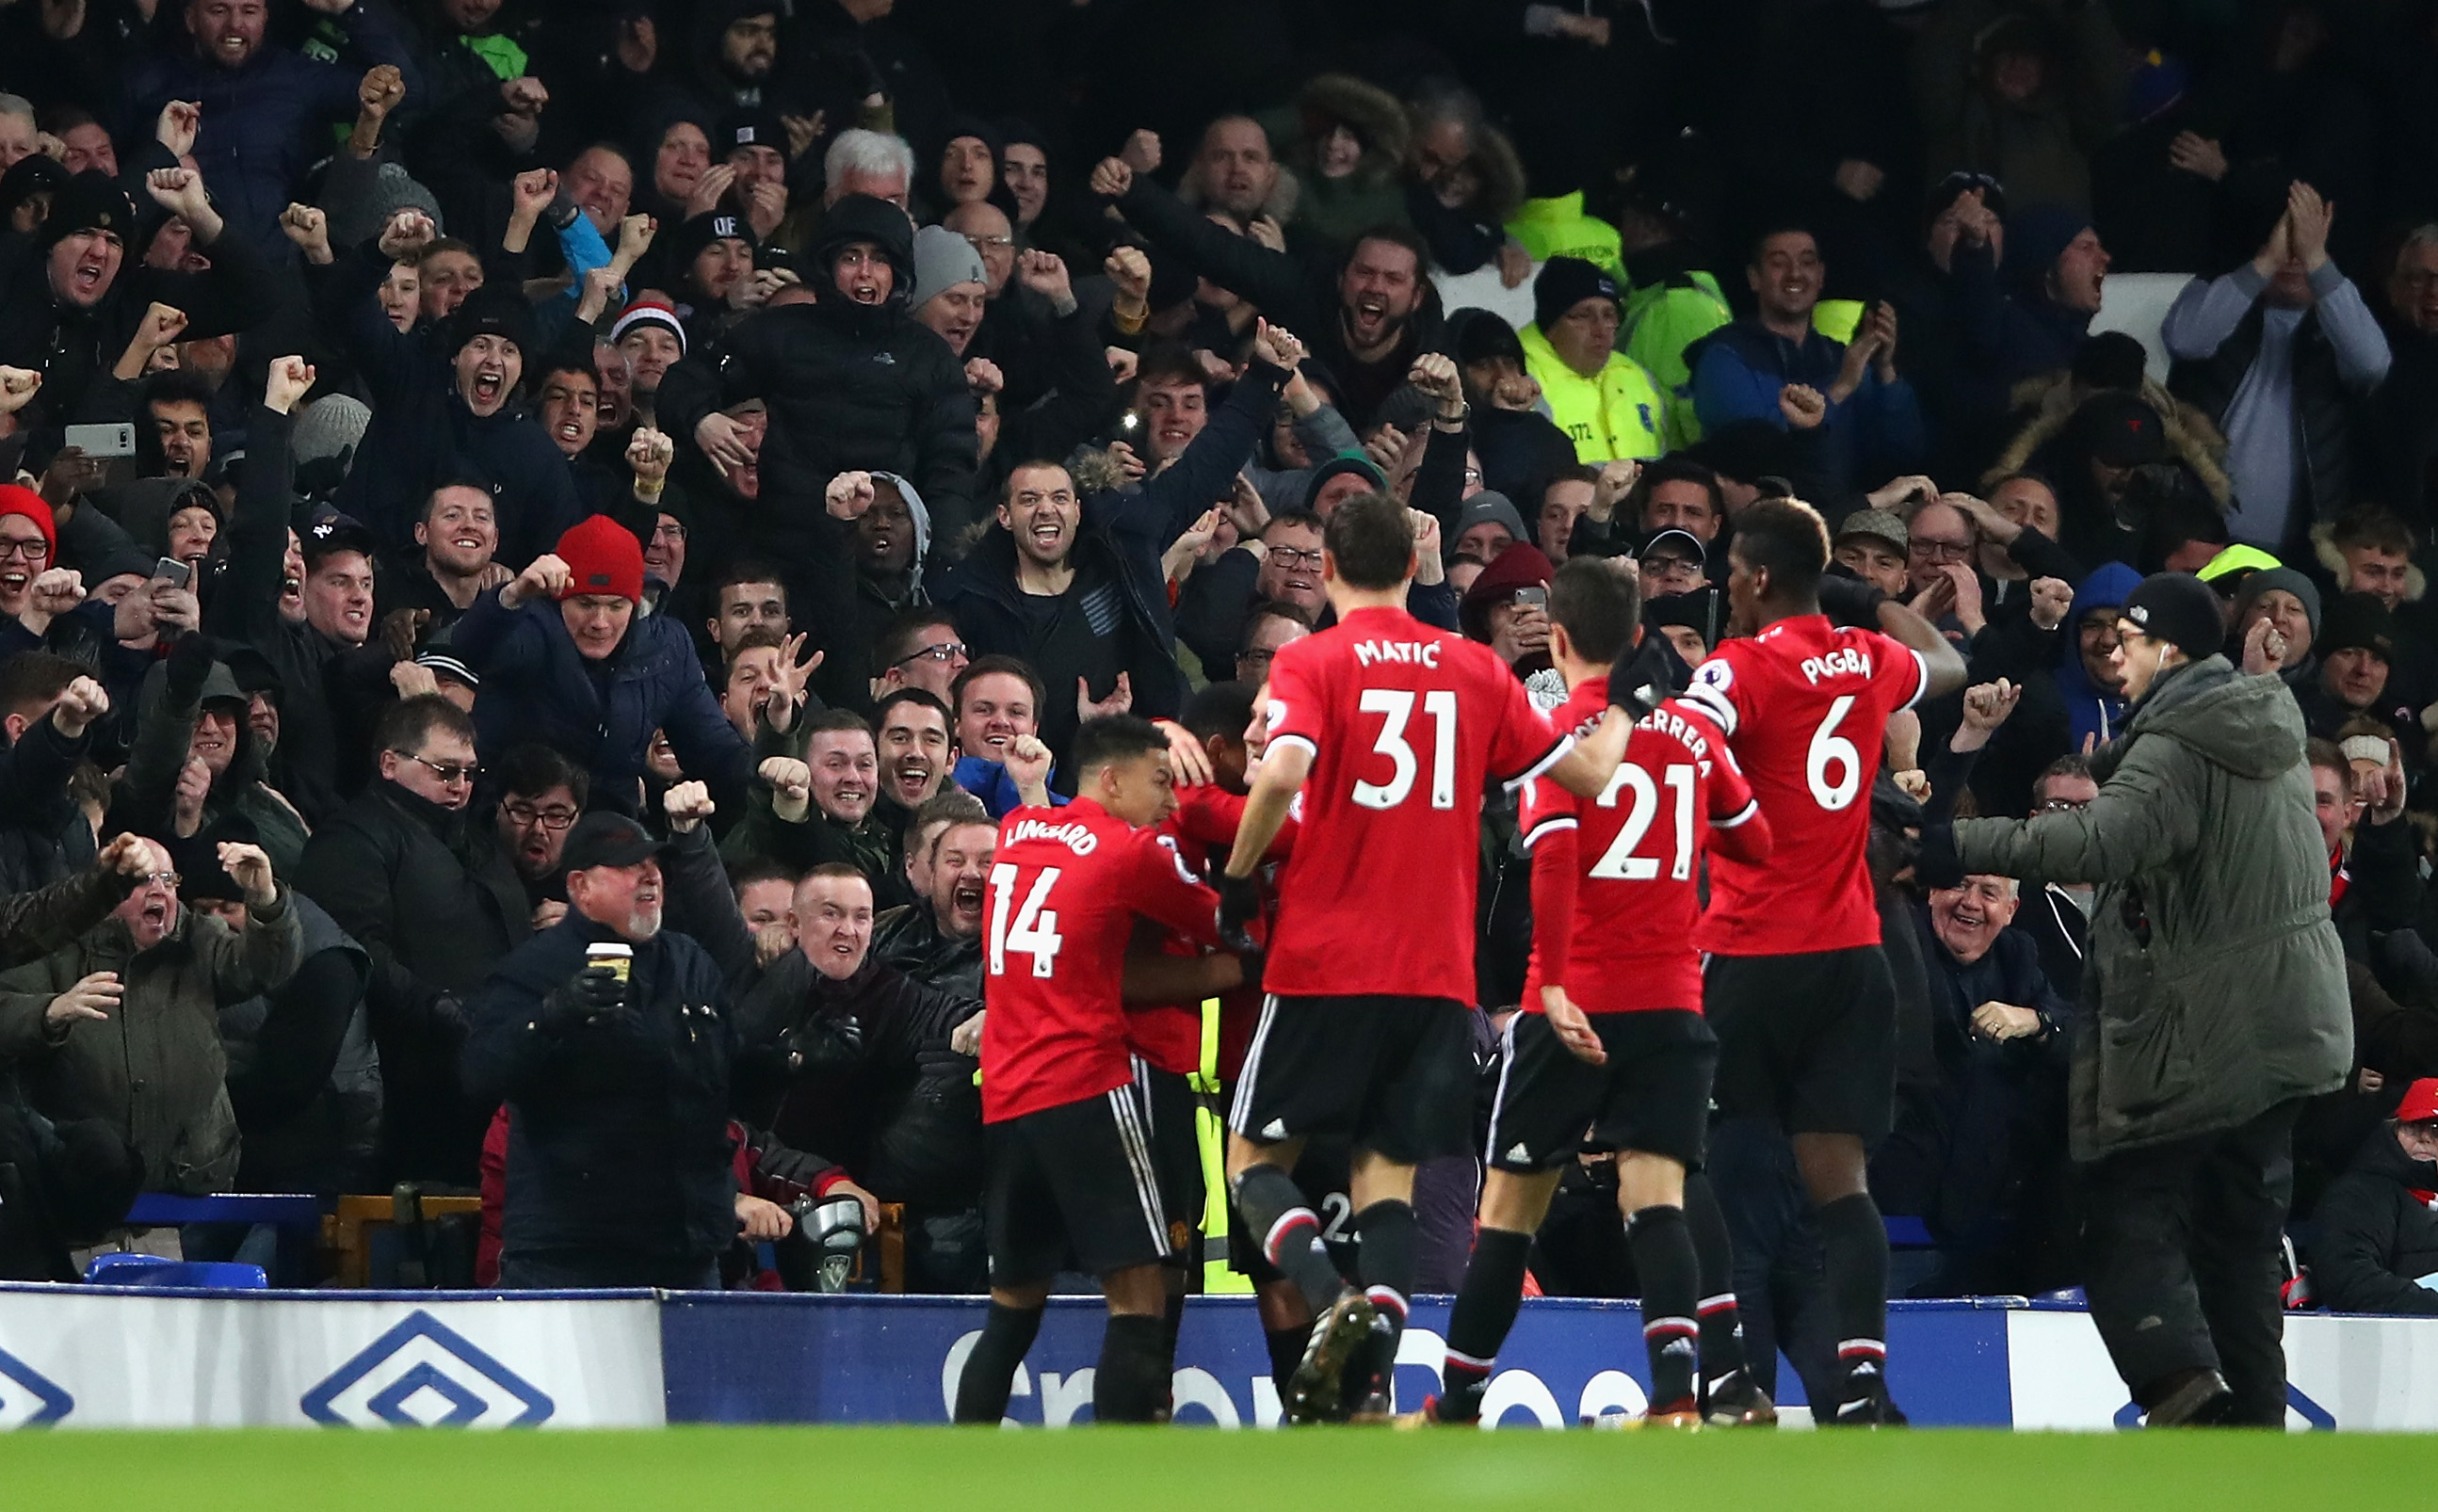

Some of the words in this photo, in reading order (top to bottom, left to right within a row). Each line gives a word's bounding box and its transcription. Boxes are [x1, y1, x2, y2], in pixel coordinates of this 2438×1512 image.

[1351, 688, 1458, 811] 31
[1635, 708, 1713, 779] ERRERA
[1806, 695, 1861, 812] 6
[1588, 762, 1696, 880] 21
[989, 862, 1064, 979] 14
